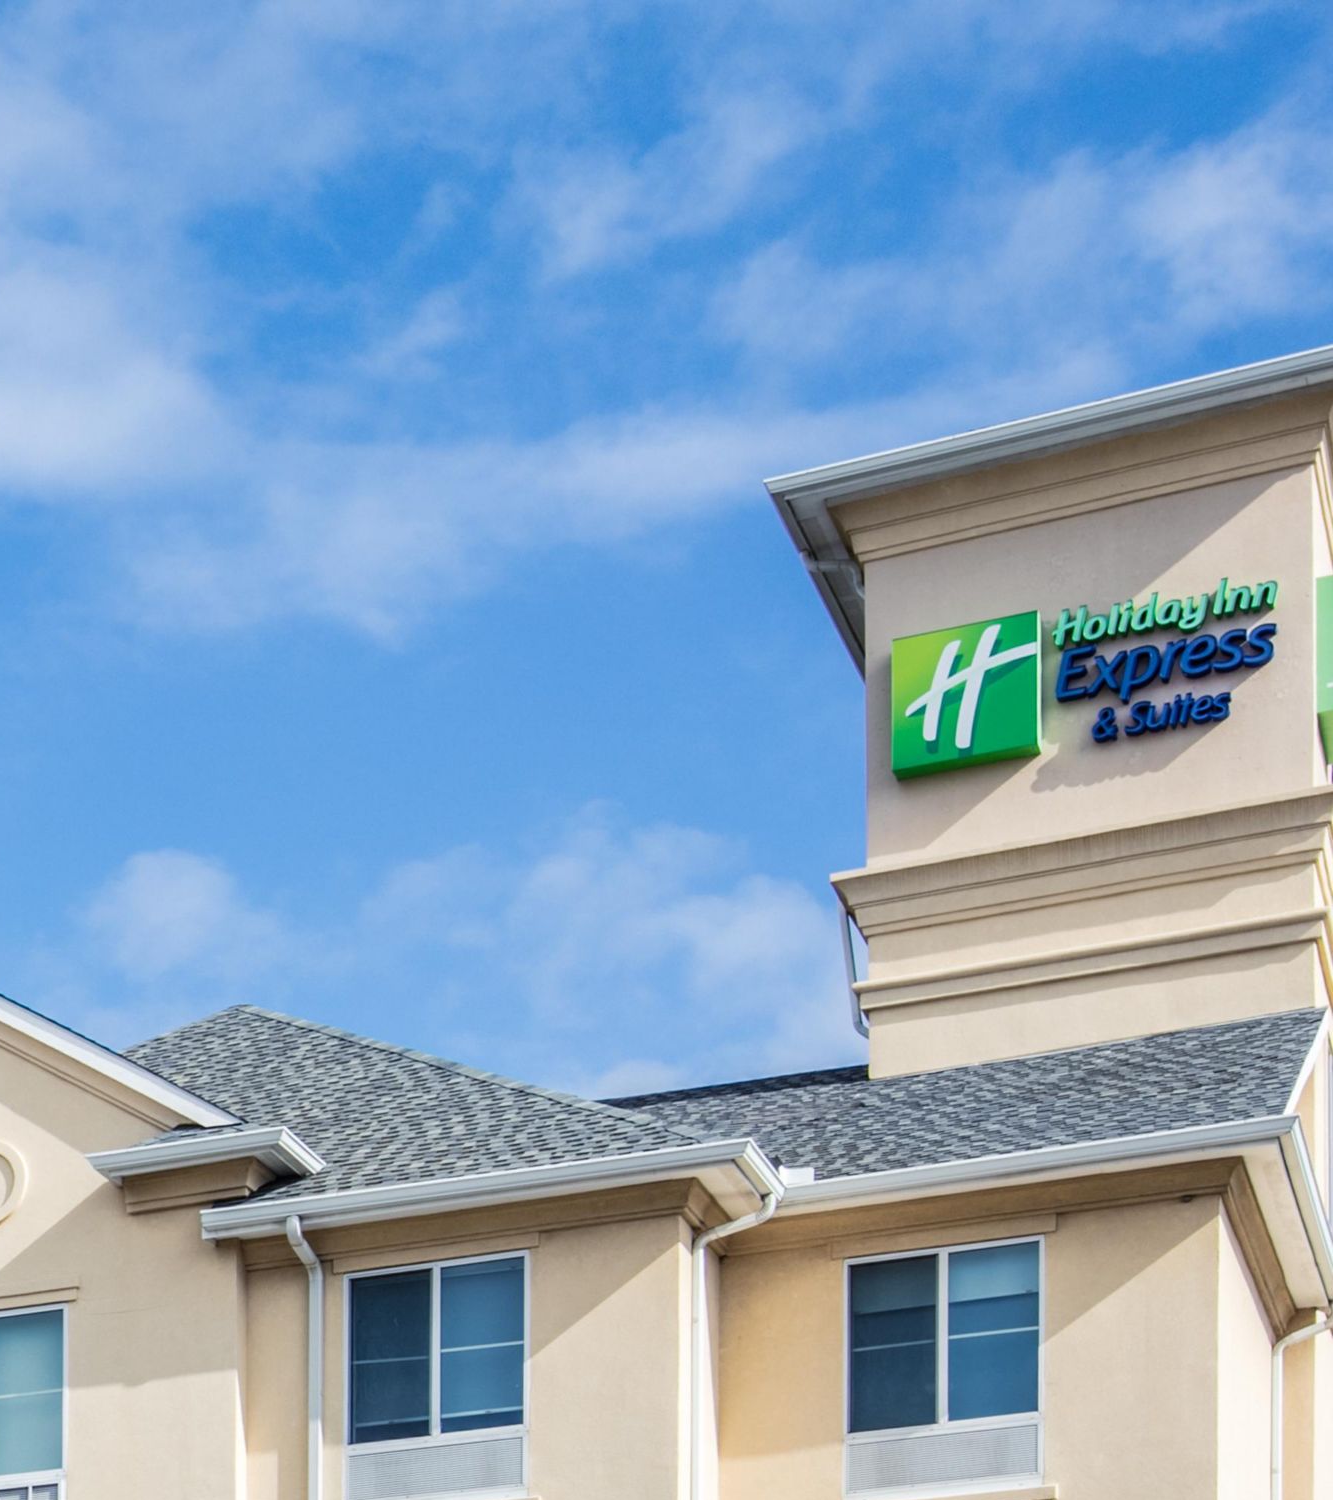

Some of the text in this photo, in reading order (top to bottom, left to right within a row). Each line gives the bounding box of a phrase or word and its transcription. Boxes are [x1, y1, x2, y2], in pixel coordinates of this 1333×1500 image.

[1051, 577, 1278, 650] Holiday Inn
[1054, 623, 1277, 704] Express
[1091, 691, 1231, 743] & Suites
